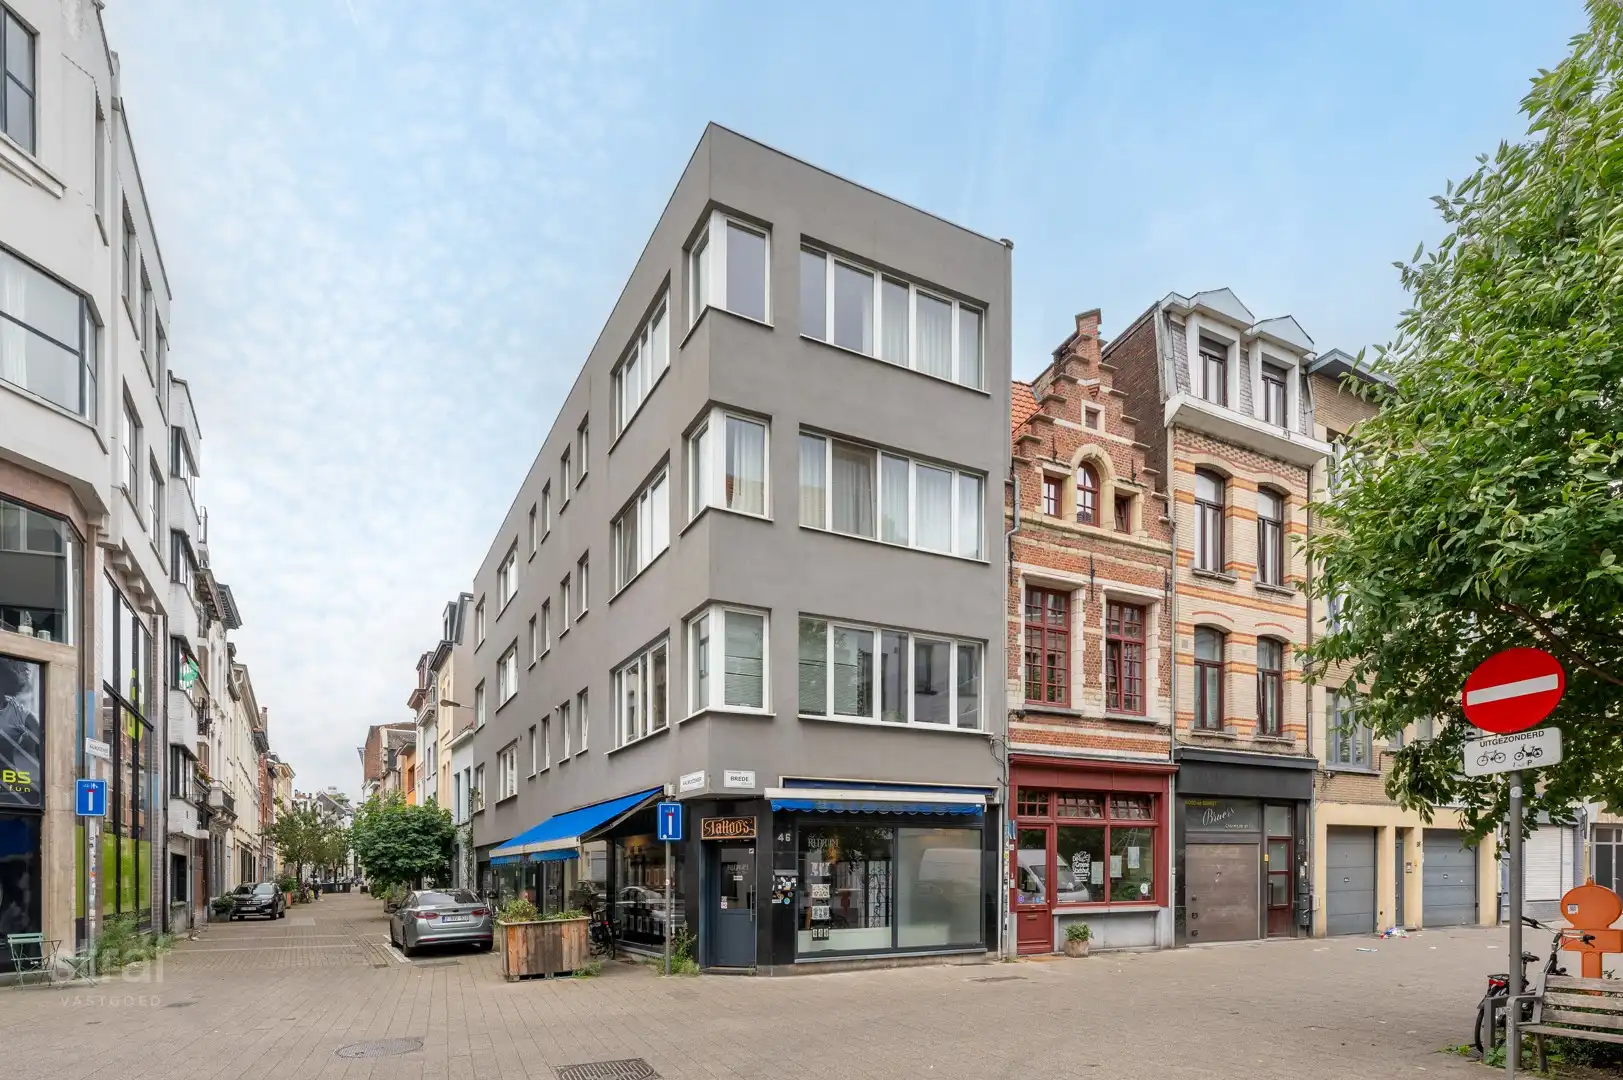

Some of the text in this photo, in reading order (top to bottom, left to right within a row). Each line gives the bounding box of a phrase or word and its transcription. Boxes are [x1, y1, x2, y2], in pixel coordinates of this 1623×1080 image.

[1479, 730, 1545, 748] UITGEZONDERD
[9, 784, 31, 793] fun
[777, 833, 791, 842] 46
